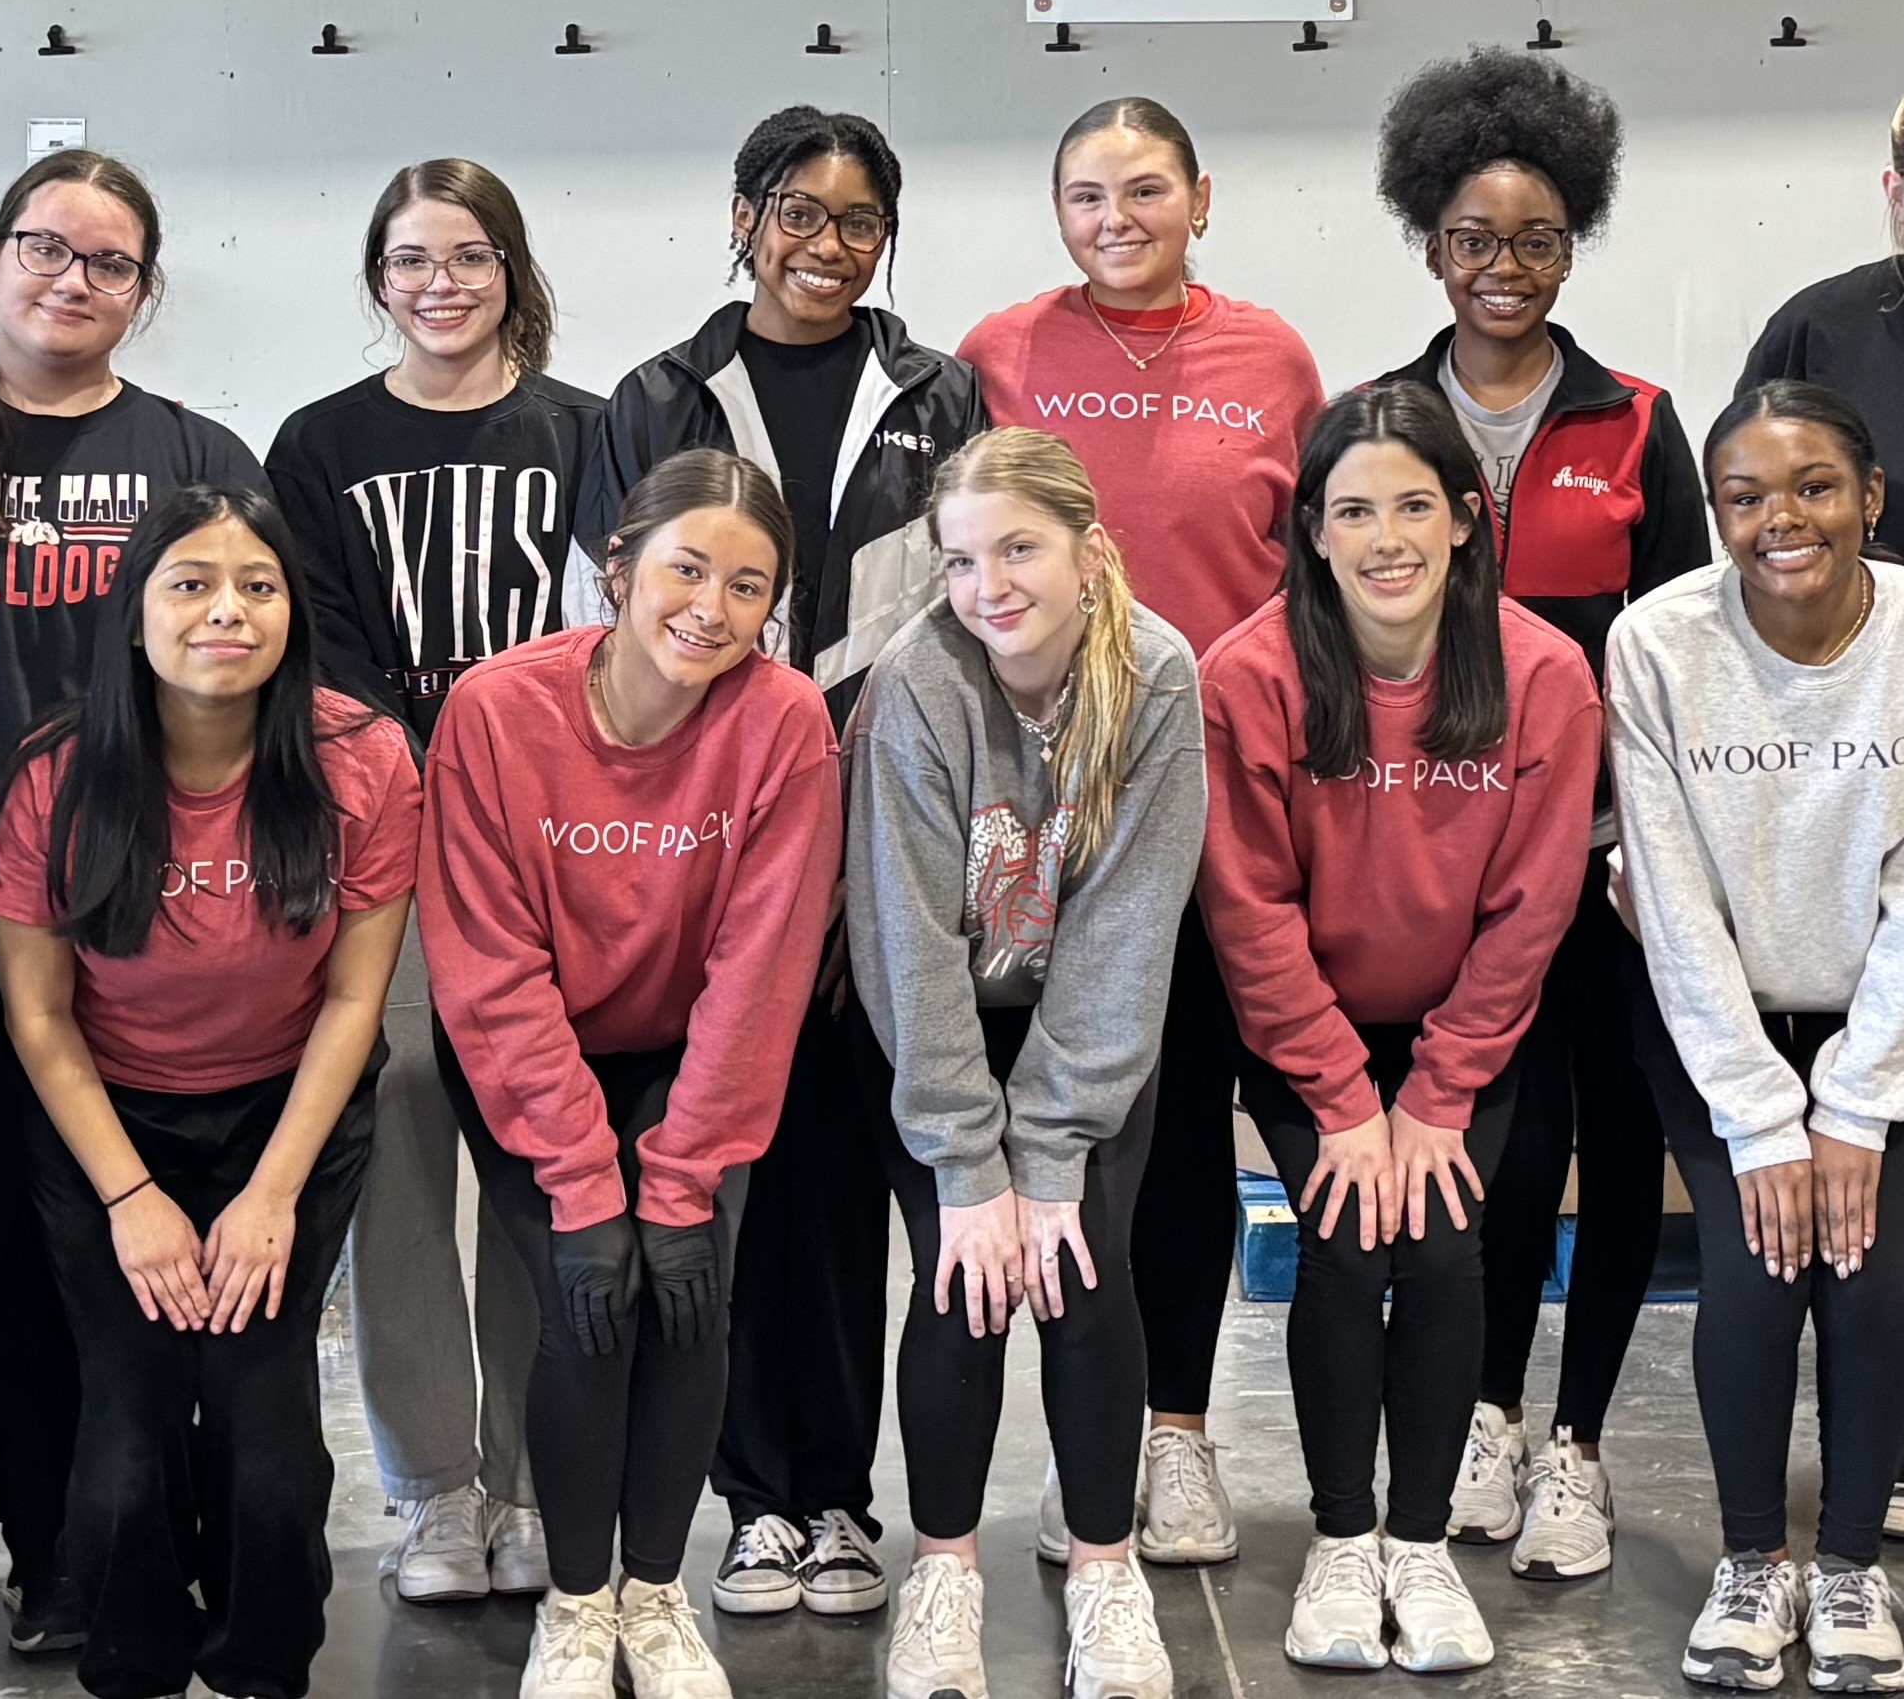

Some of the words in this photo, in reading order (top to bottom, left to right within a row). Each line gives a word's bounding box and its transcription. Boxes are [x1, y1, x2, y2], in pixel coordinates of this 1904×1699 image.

[1034, 392, 1162, 419] WOOF
[1172, 395, 1266, 436] PACK
[1552, 465, 1610, 495] Amiya
[343, 464, 557, 667] WHS
[1413, 759, 1508, 791] PACK
[1688, 741, 1813, 774] WOOF
[538, 817, 653, 854] WOOF
[658, 811, 734, 857] PACK
